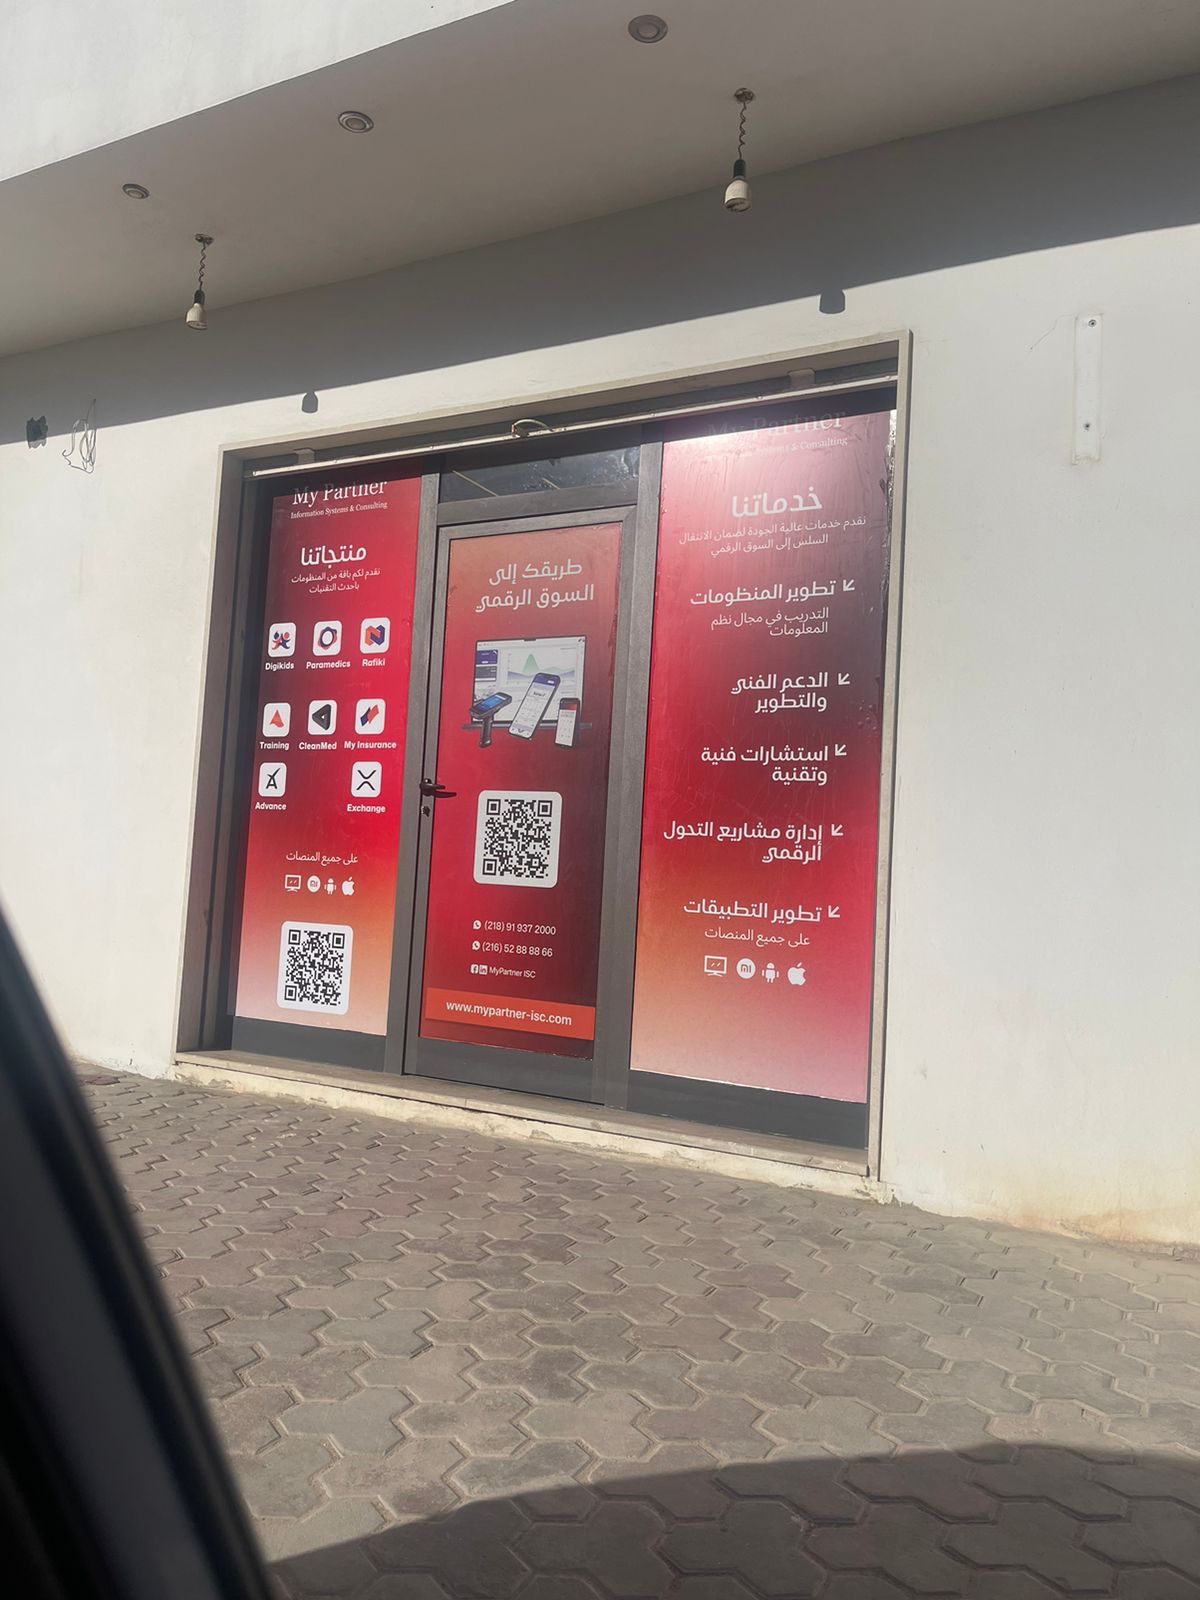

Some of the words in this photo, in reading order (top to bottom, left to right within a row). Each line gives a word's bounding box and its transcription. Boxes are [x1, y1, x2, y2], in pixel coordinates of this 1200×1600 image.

[292, 487, 318, 508] My
[323, 481, 388, 501] Partner
[731, 486, 823, 518] خدماتنا
[290, 509, 324, 519] Information
[325, 506, 349, 516] Systems
[349, 505, 354, 513] &
[355, 501, 388, 513] Consulting
[779, 521, 802, 533] عالية
[805, 519, 841, 531] خدمات
[843, 515, 866, 530] نقدم
[679, 530, 712, 545] الانتقال
[714, 527, 746, 541] لضمان
[747, 524, 777, 538] الجودة
[743, 539, 774, 554] السوق
[775, 538, 791, 551] إلى
[793, 533, 829, 549] السلس
[301, 544, 367, 568] منتجاتنا
[711, 542, 742, 558] الرقمي
[339, 569, 351, 579] باقة
[352, 568, 364, 580] لكم
[364, 568, 380, 579] نقدم
[489, 563, 517, 586] إلى
[522, 558, 583, 581] طريقك
[291, 572, 326, 584] المنظومات
[327, 573, 337, 582] من
[309, 583, 336, 595] التقنيات
[536, 584, 594, 609] السوق
[690, 583, 783, 607] المنظومات
[785, 580, 837, 602] تطوير
[475, 588, 531, 613] الرقمي
[711, 615, 732, 630] نظم
[734, 613, 762, 628] مجال
[765, 610, 782, 628] في
[784, 607, 829, 623] التدريب
[769, 621, 828, 638] المعلومات
[265, 661, 294, 672] Digikids
[306, 660, 351, 670] Paramedics
[362, 658, 385, 667] Rafiki
[731, 673, 777, 695] الفني
[779, 672, 828, 693] الدعم
[755, 692, 828, 714] والتطوير
[260, 741, 289, 751] Training
[299, 741, 337, 751] CleanMed
[344, 741, 356, 750] My
[357, 741, 397, 749] Insurance
[701, 746, 736, 765] فنية
[740, 745, 828, 766] استشارات
[772, 766, 828, 786] وتقنية
[255, 801, 287, 811] Advance
[347, 804, 386, 814] Exchange
[663, 820, 714, 840] التحول
[716, 822, 781, 842] مشاريع
[785, 824, 822, 845] إدارة
[286, 851, 321, 862] المنصات
[321, 856, 341, 867] جميع
[343, 854, 358, 866] على
[762, 845, 822, 865] الرقمي
[683, 898, 768, 920] التطبيقات
[771, 905, 822, 925] تطوير
[484, 919, 504, 932] (218)
[506, 922, 515, 932] 91
[517, 923, 533, 933] 937
[535, 925, 556, 936] 2000
[704, 926, 754, 942] المنصات
[755, 933, 785, 948] جميع
[788, 933, 811, 948] على
[482, 942, 502, 954] (216)
[504, 944, 515, 954] 52
[516, 945, 527, 955] 88
[528, 946, 540, 956] 88
[542, 947, 553, 957] 66
[489, 966, 522, 977] MyPartner
[524, 969, 536, 979] ISC
[446, 1001, 572, 1026] www.mypartner-isc.com
